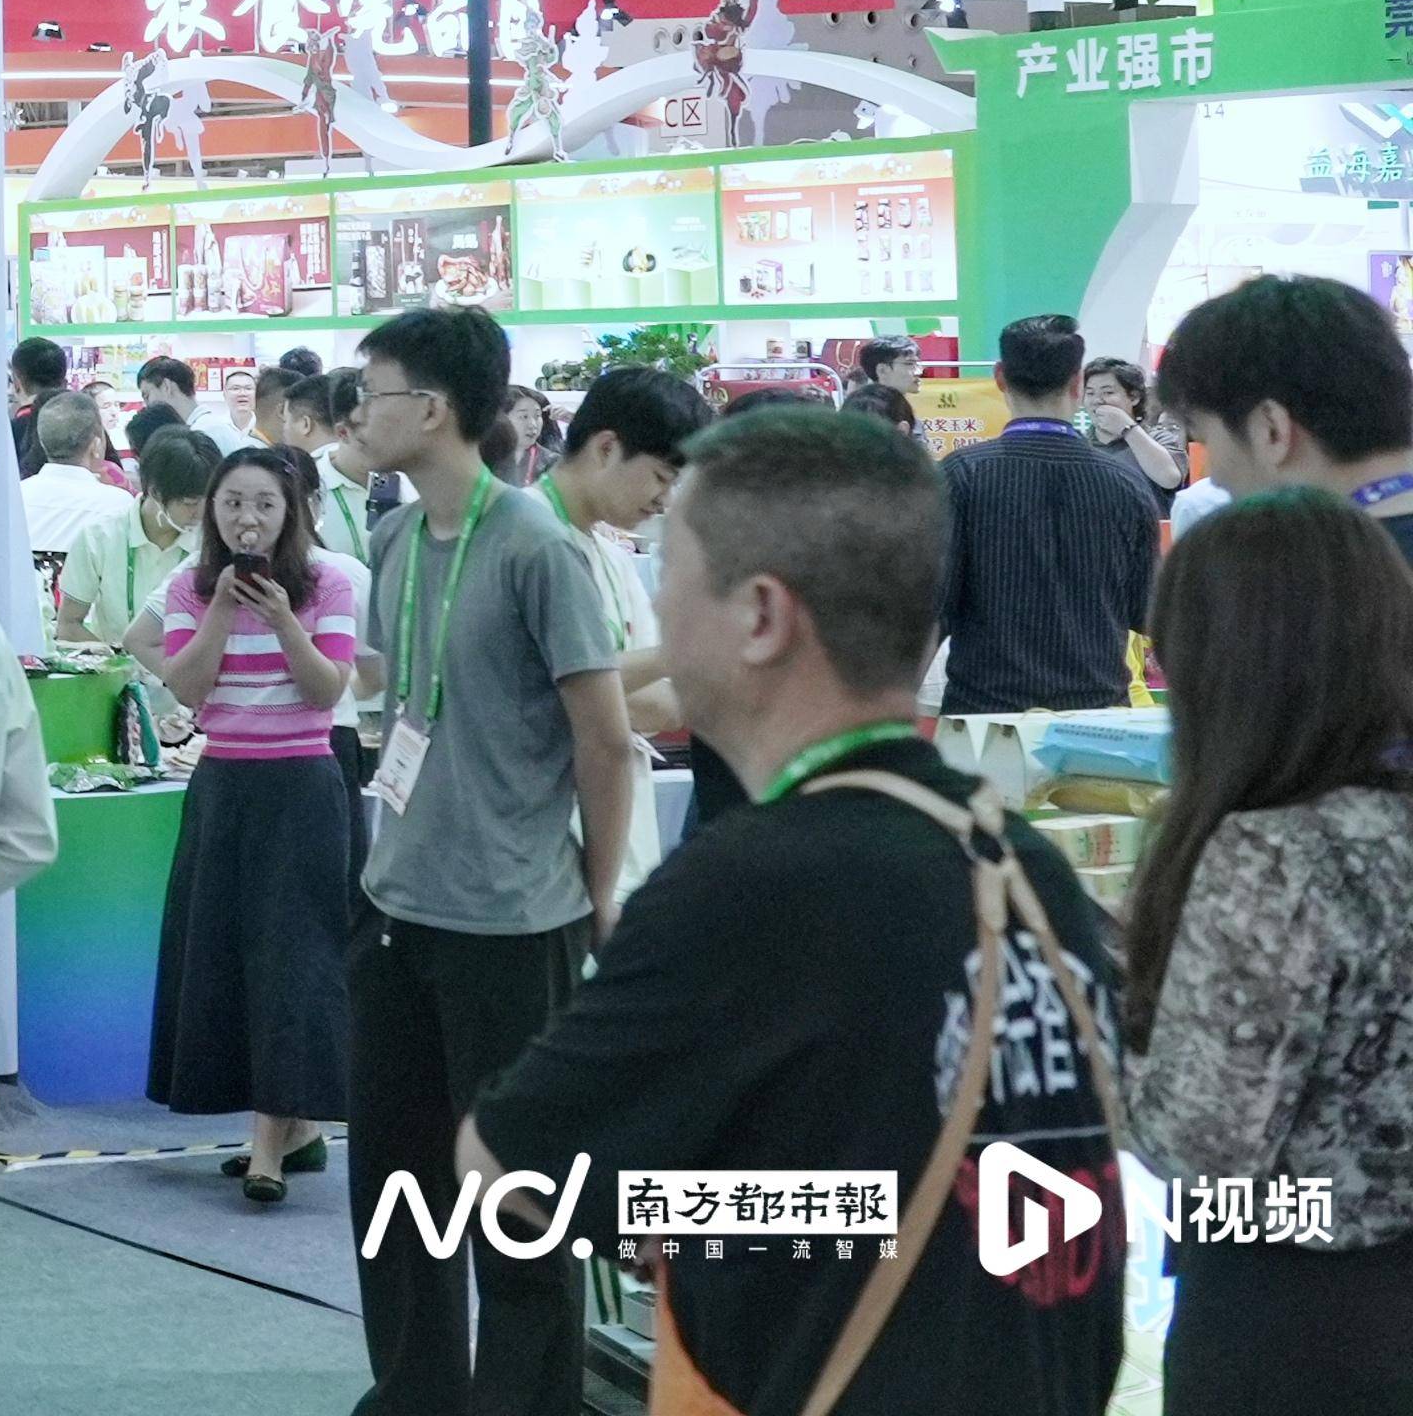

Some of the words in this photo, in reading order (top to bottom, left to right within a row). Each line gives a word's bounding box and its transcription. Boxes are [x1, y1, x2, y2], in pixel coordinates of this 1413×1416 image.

[1015, 27, 1215, 98] 产业强市
[664, 96, 702, 128] C区
[1303, 141, 1413, 183] 益海嘉
